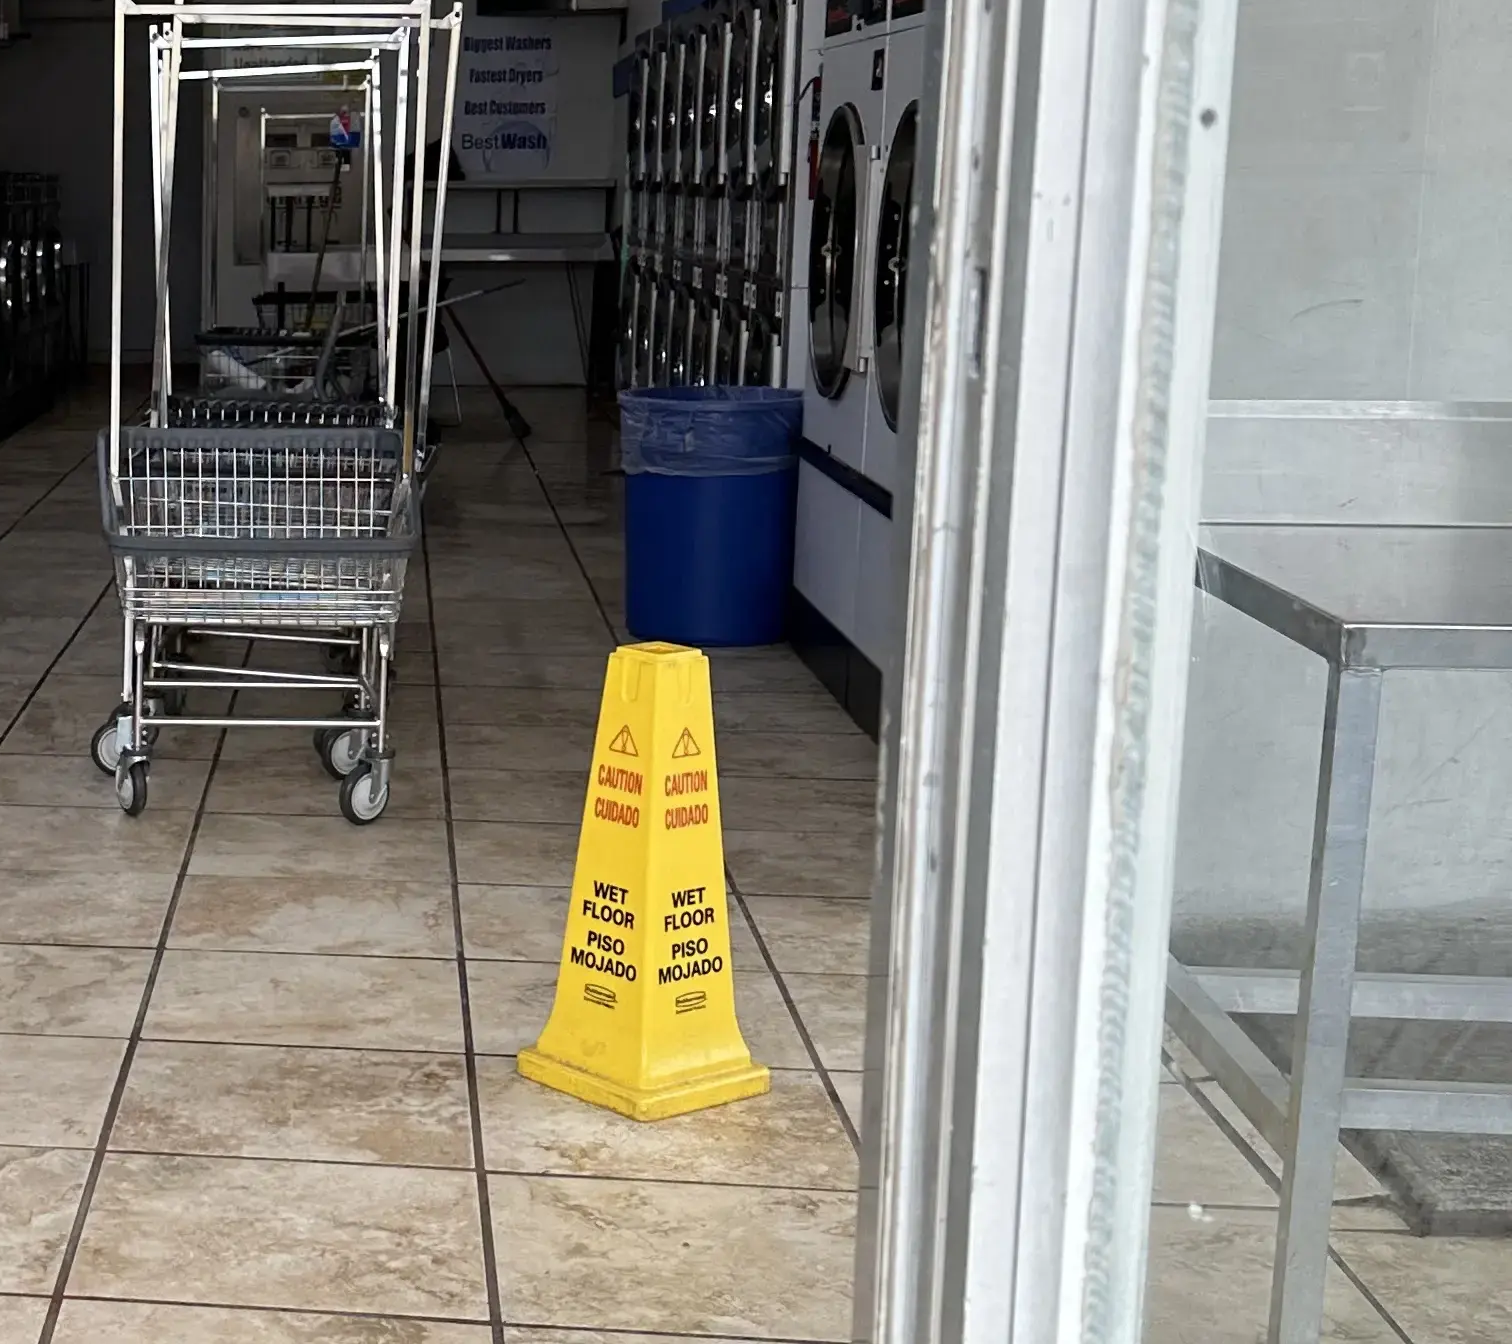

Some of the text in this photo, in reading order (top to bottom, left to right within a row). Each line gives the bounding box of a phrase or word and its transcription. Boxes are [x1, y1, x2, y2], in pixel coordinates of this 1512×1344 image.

[463, 36, 552, 53] Biggest Washers
[470, 68, 543, 85] Fastest Dryers
[464, 100, 546, 115] Best Customers
[598, 764, 643, 796] CAUTION
[665, 770, 707, 797] CAUTION
[595, 797, 640, 828] CUIDADO
[665, 803, 708, 830] CUIDADO
[593, 880, 629, 905] WET
[671, 887, 706, 908] WET
[582, 899, 635, 930] FLOOR
[664, 907, 715, 932] FLOOR
[587, 930, 625, 956] PISO
[672, 938, 709, 960] PISO
[570, 946, 637, 982] MOJADO
[658, 956, 723, 985] MOJADO
